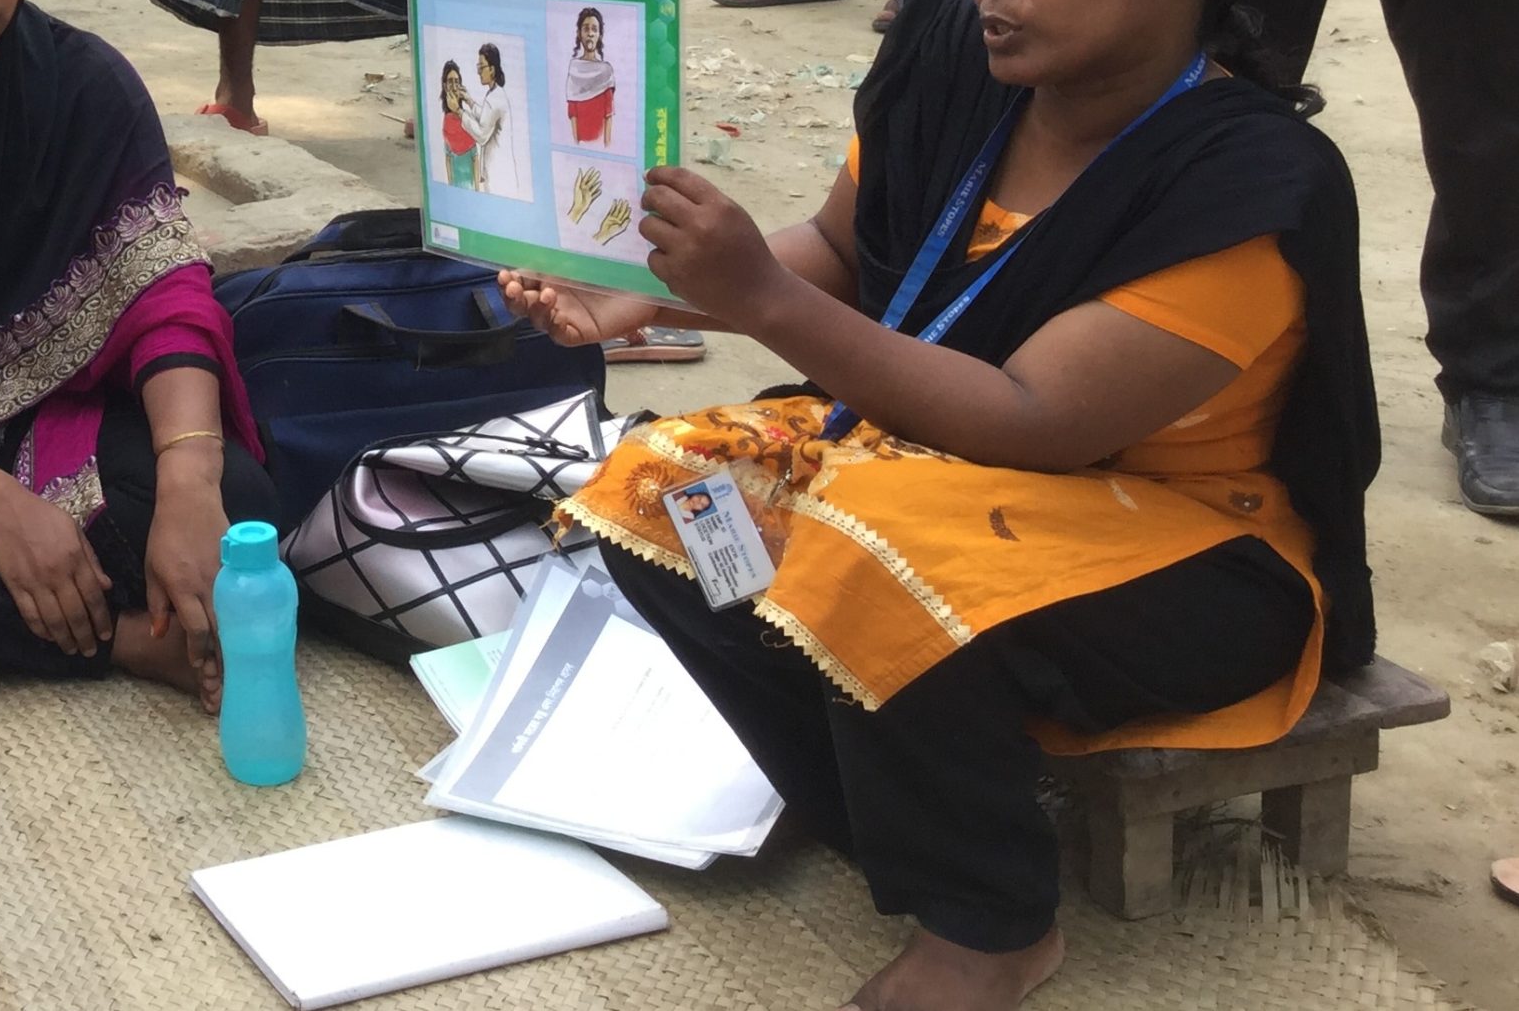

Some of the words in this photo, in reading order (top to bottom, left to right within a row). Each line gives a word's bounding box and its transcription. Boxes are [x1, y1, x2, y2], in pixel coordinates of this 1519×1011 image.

[960, 160, 986, 198] MARIE
[937, 198, 965, 238] STOPES
[936, 294, 971, 331] STOPES
